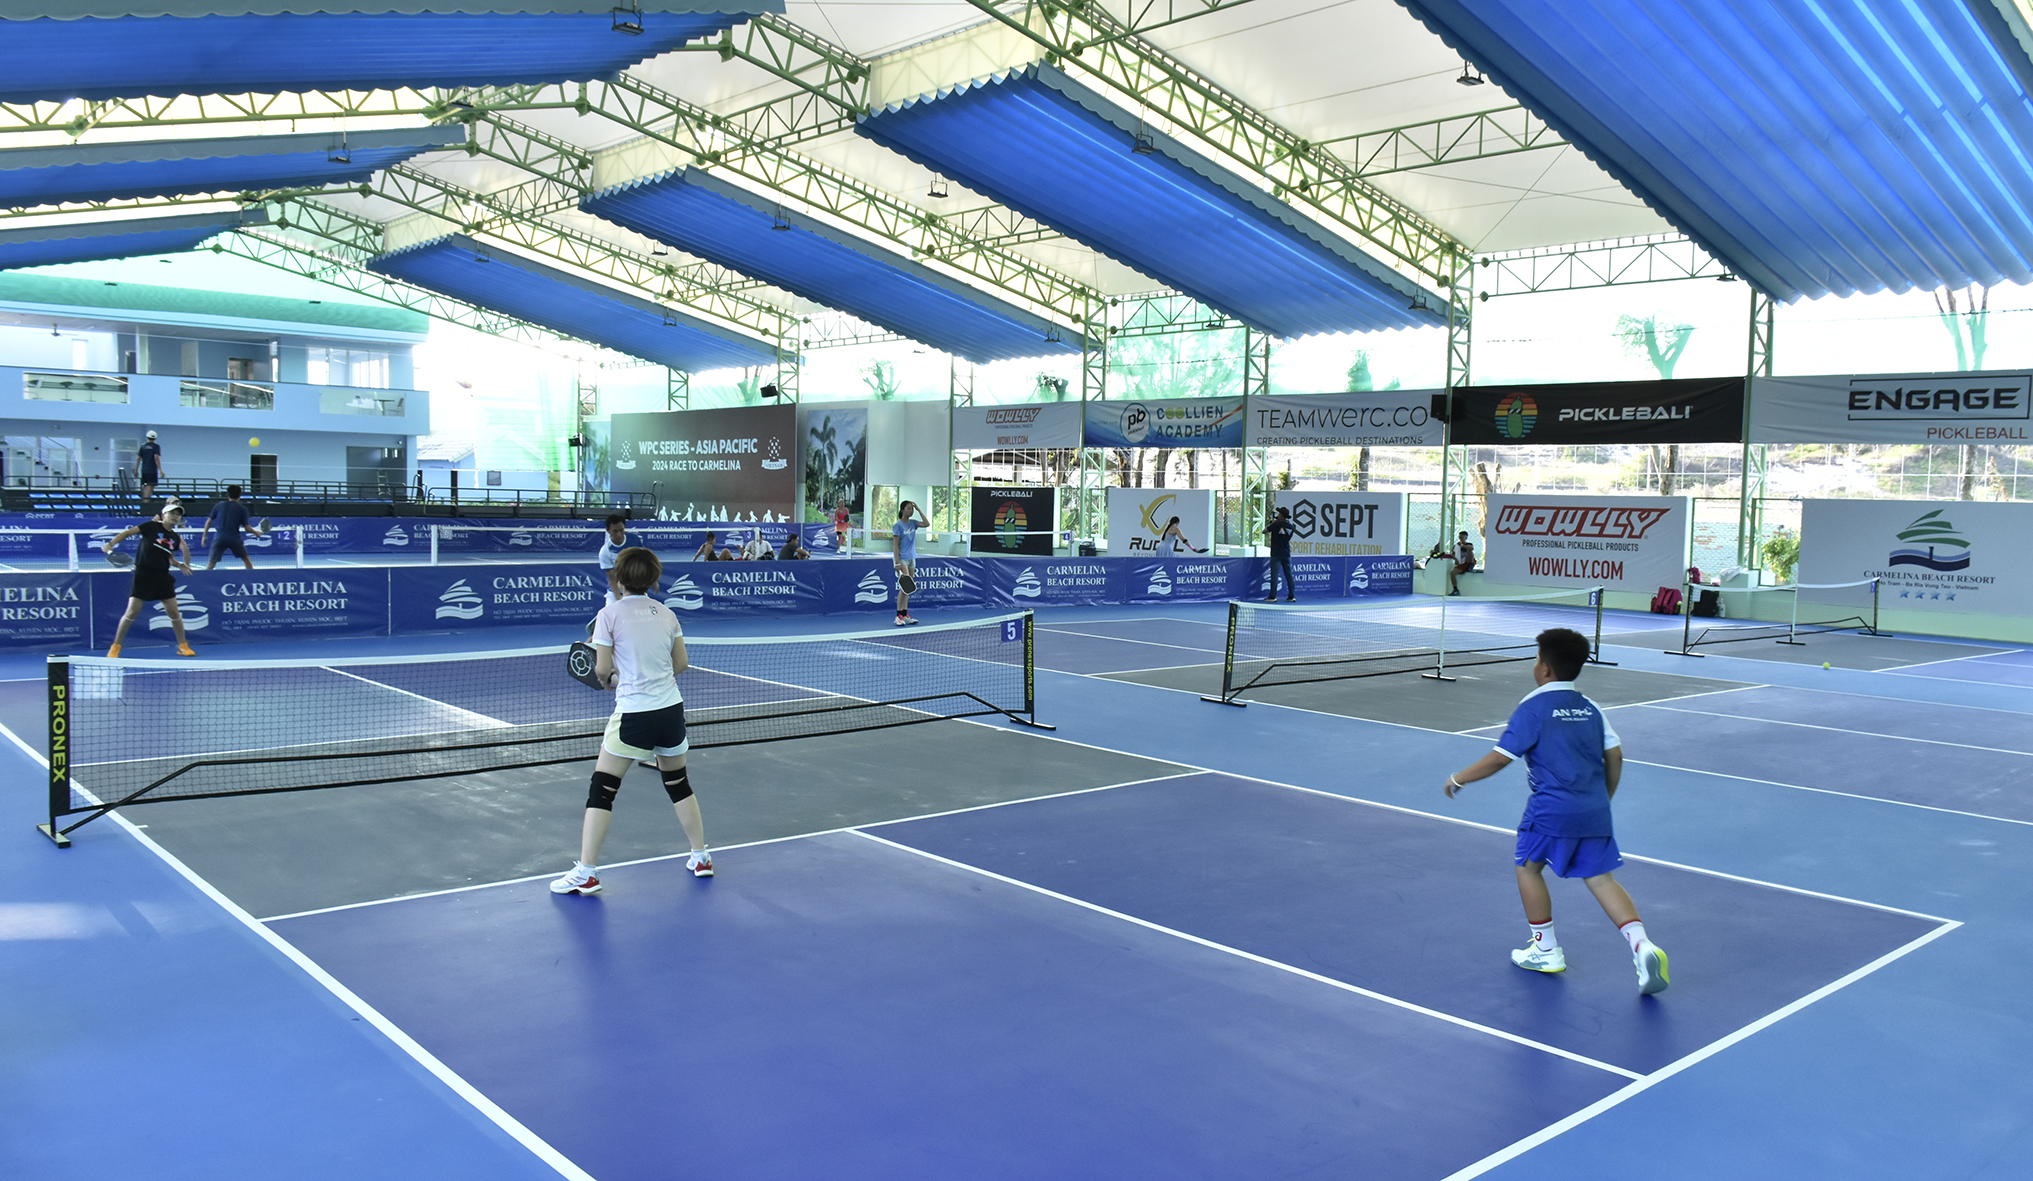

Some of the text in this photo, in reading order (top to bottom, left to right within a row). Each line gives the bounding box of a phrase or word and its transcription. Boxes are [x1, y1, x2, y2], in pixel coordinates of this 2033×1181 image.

[1849, 387, 2021, 412] ENGAGE
[986, 407, 1042, 424] WOWLLY
[1127, 408, 1146, 430] pb
[1559, 406, 1690, 421] PICKLEBALI
[1156, 424, 1223, 438] ACADEMY
[1927, 427, 2028, 439] PICKLEBALL
[638, 441, 660, 455] WPC
[660, 440, 690, 455] SERIES
[696, 439, 717, 454] ASIA
[719, 438, 758, 454] PACIFIC
[997, 435, 1029, 445] WOWLLY.COM
[1257, 436, 1424, 445] CREATING PICKLEBALL DESTINATIONS
[652, 460, 741, 470] 2024 RACE TO CARMELINA
[1320, 503, 1379, 539] SEPT
[1495, 505, 1671, 539] WOWLLY
[284, 531, 290, 540] 2
[1315, 542, 1383, 556] REHABILITATION
[1522, 539, 1639, 552] PROFESSIONAL PICKLEBALL PRODUCTS
[1046, 565, 1106, 575] CARMELINA
[1176, 564, 1227, 574] CARMELINA
[1290, 563, 1331, 572] ARMELINA
[1371, 562, 1411, 571] CARMELINA
[1529, 557, 1624, 580] WOWLLY.COM
[492, 575, 593, 590] CARMELINA
[711, 571, 796, 584] CARMELINA
[1047, 577, 1106, 586] BEACH RESORT
[1176, 576, 1227, 585] BEACH RESORT
[1311, 573, 1331, 581] RESORT
[1863, 570, 1996, 584] CARMELINA BEACH RESORT
[220, 581, 347, 597] CARMELINA
[712, 585, 797, 597] BEACH RESORT
[929, 580, 964, 590] RESORT
[493, 590, 595, 604] BEACH RESORT
[1591, 592, 1596, 605] 6
[222, 598, 348, 613] BEACH RESORT
[2, 606, 81, 620] RESORT
[1007, 621, 1016, 640] 5
[1226, 617, 1235, 672] PRONEX
[53, 685, 66, 783] PRONEX
